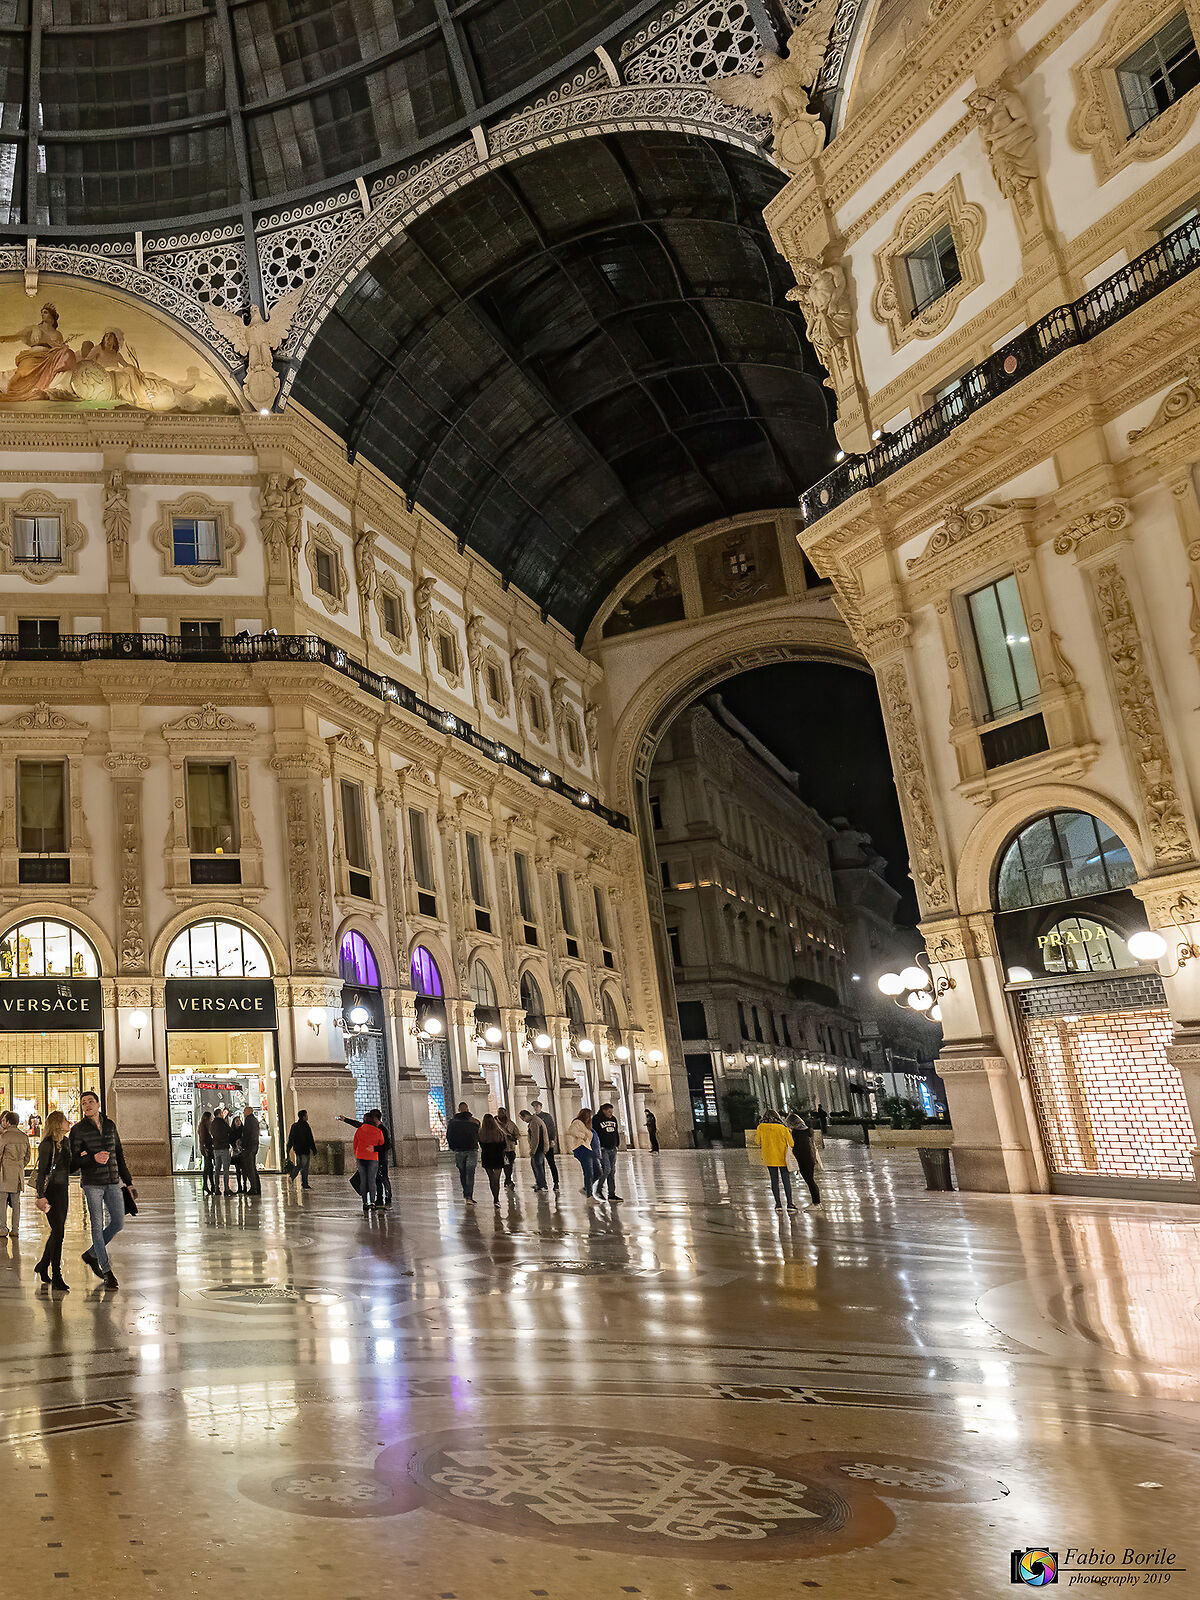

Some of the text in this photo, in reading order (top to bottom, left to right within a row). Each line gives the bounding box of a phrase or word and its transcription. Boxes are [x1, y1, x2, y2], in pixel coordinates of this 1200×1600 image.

[1037, 926, 1109, 949] PRADA
[3, 998, 90, 1012] VERSACE
[178, 997, 264, 1011] VERSACE
